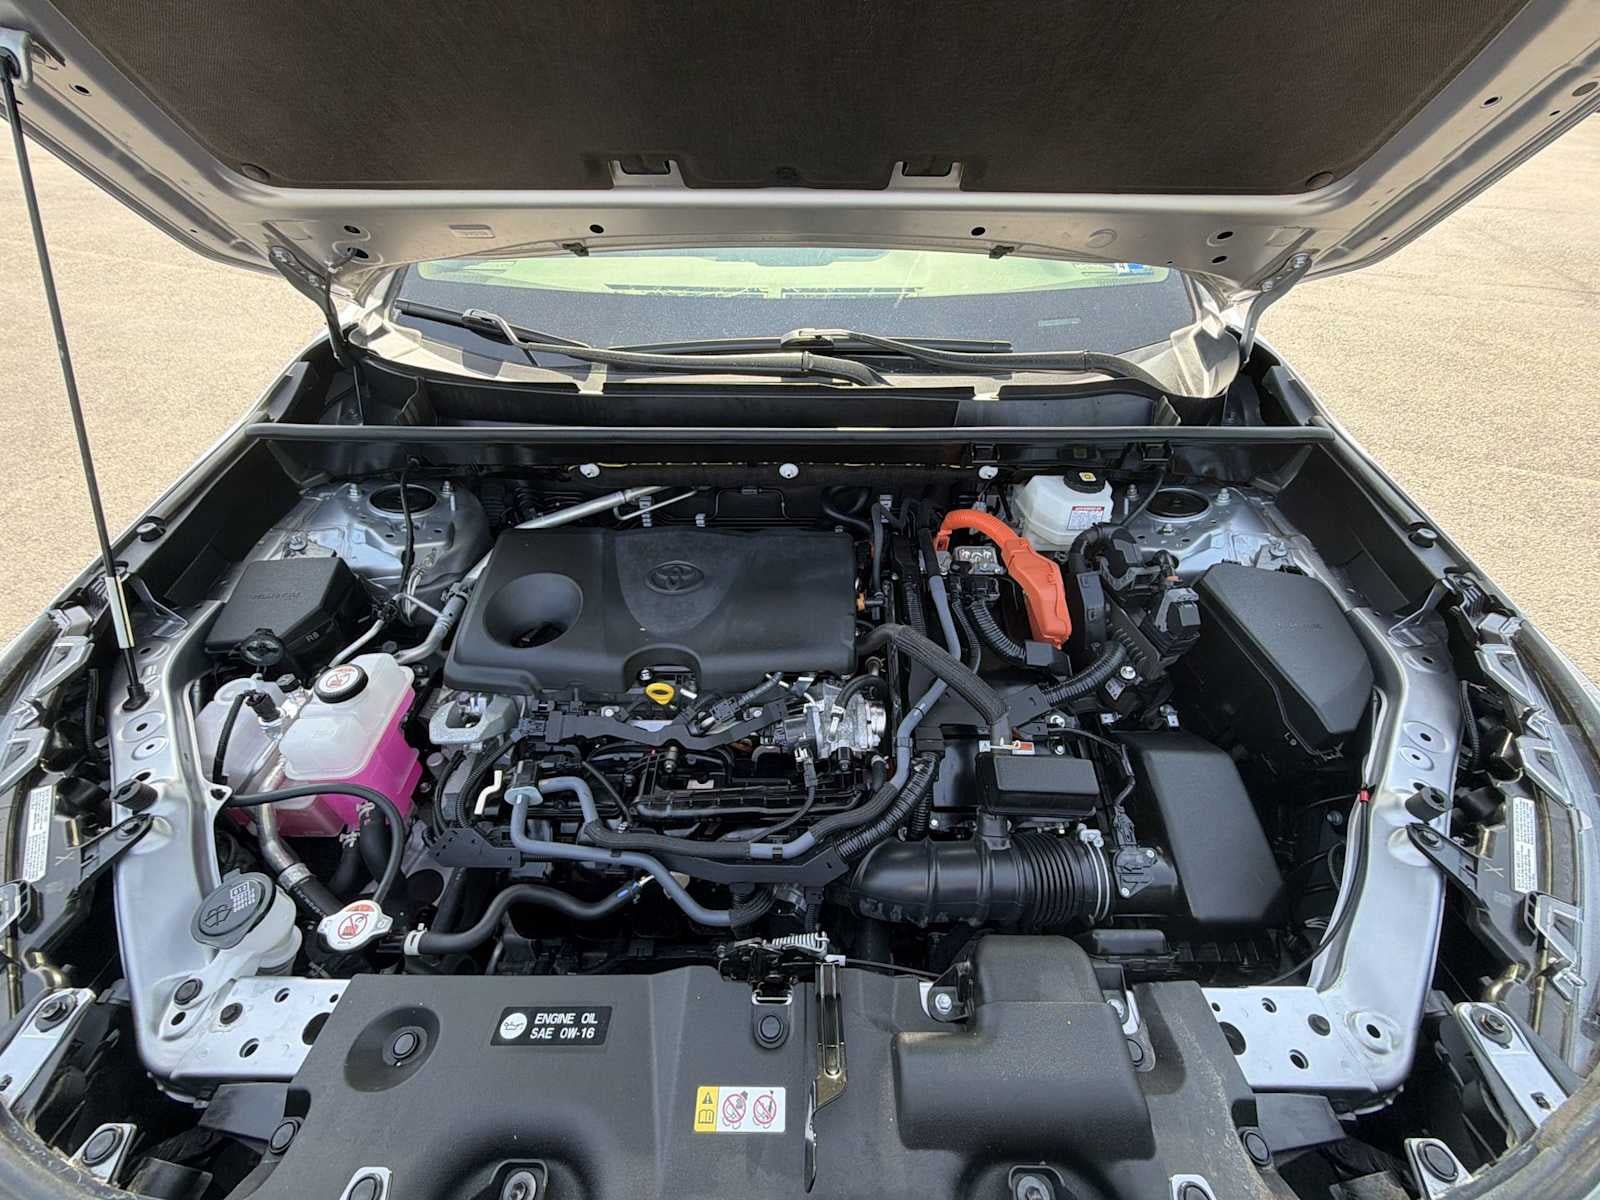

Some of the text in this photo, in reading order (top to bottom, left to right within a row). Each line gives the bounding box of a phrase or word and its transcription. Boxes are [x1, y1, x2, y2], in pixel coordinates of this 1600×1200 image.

[534, 1013, 598, 1024] ENGINE OIL
[529, 1027, 595, 1039] SAE 0W-16
